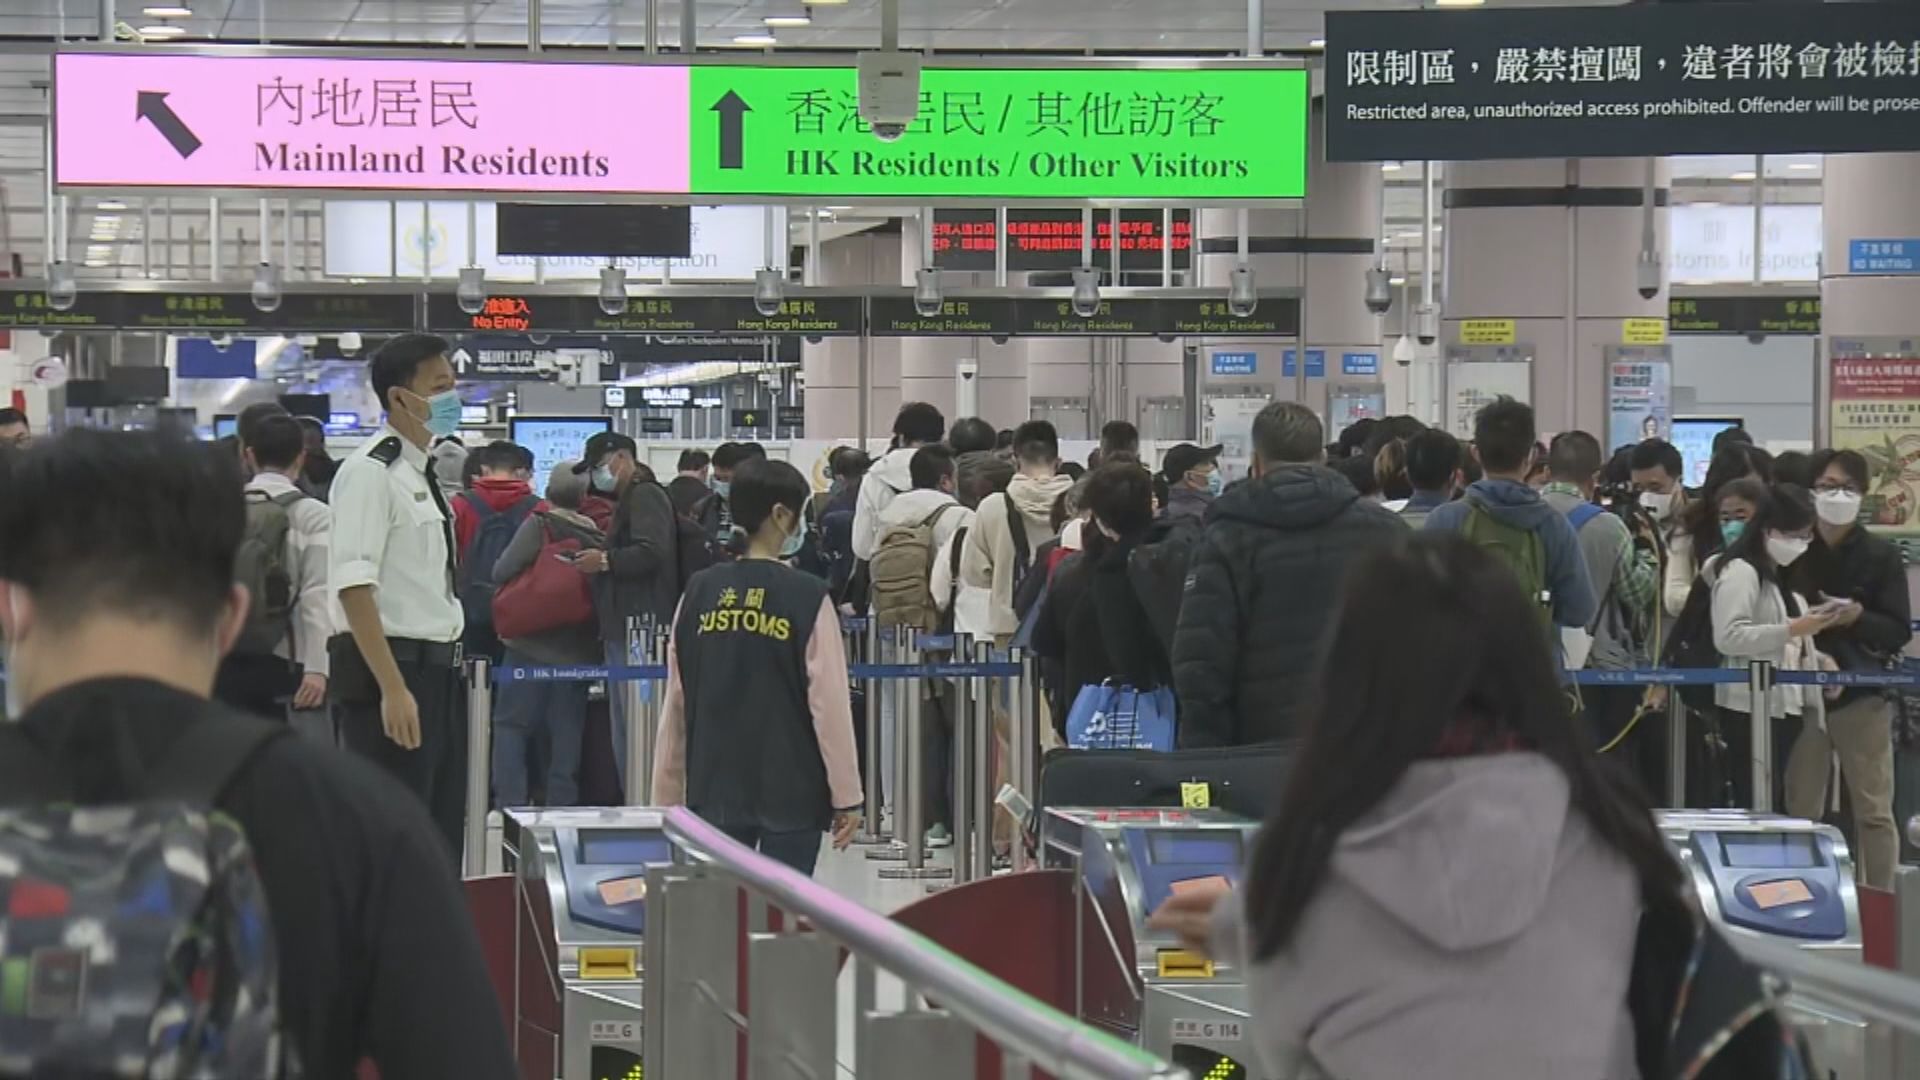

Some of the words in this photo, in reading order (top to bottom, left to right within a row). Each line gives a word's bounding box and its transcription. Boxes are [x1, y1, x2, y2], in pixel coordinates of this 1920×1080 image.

[256, 76, 479, 129] 內地居民
[1346, 103, 1427, 120] Restricted
[1431, 105, 1470, 121] area,
[1474, 101, 1583, 118] unauthorized
[1587, 102, 1640, 117] access
[1644, 98, 1735, 118] prohibited.
[1738, 97, 1813, 115] Offender
[1816, 95, 1844, 112] will
[1848, 96, 1870, 112] be
[1873, 97, 1920, 115] prose
[998, 94, 1012, 133] /
[1025, 88, 1225, 138] 其他訪客
[255, 142, 425, 174] Mainland
[441, 145, 610, 178] Residents
[785, 150, 840, 175] HK
[852, 150, 1000, 178] Residents
[1008, 150, 1021, 177] /
[1029, 151, 1121, 178] Other
[1130, 153, 1250, 180] Visitors
[1869, 258, 1913, 270] WAITING
[473, 316, 493, 329] No
[494, 317, 529, 332] Entry
[737, 319, 764, 332] Hong
[765, 319, 791, 332] Kong
[791, 319, 838, 331] Residents
[892, 320, 918, 333] Hong
[919, 320, 944, 333] Kong
[945, 320, 992, 331] Residents
[1033, 320, 1060, 333] Hong
[1061, 320, 1087, 333] Kong
[1087, 320, 1133, 331] Residents
[1175, 320, 1201, 333] Hong
[1203, 320, 1228, 333] Kong
[1229, 320, 1275, 331] Residents
[533, 668, 551, 678] HK
[553, 668, 609, 680] Immigration
[1203, 1023, 1214, 1037] G
